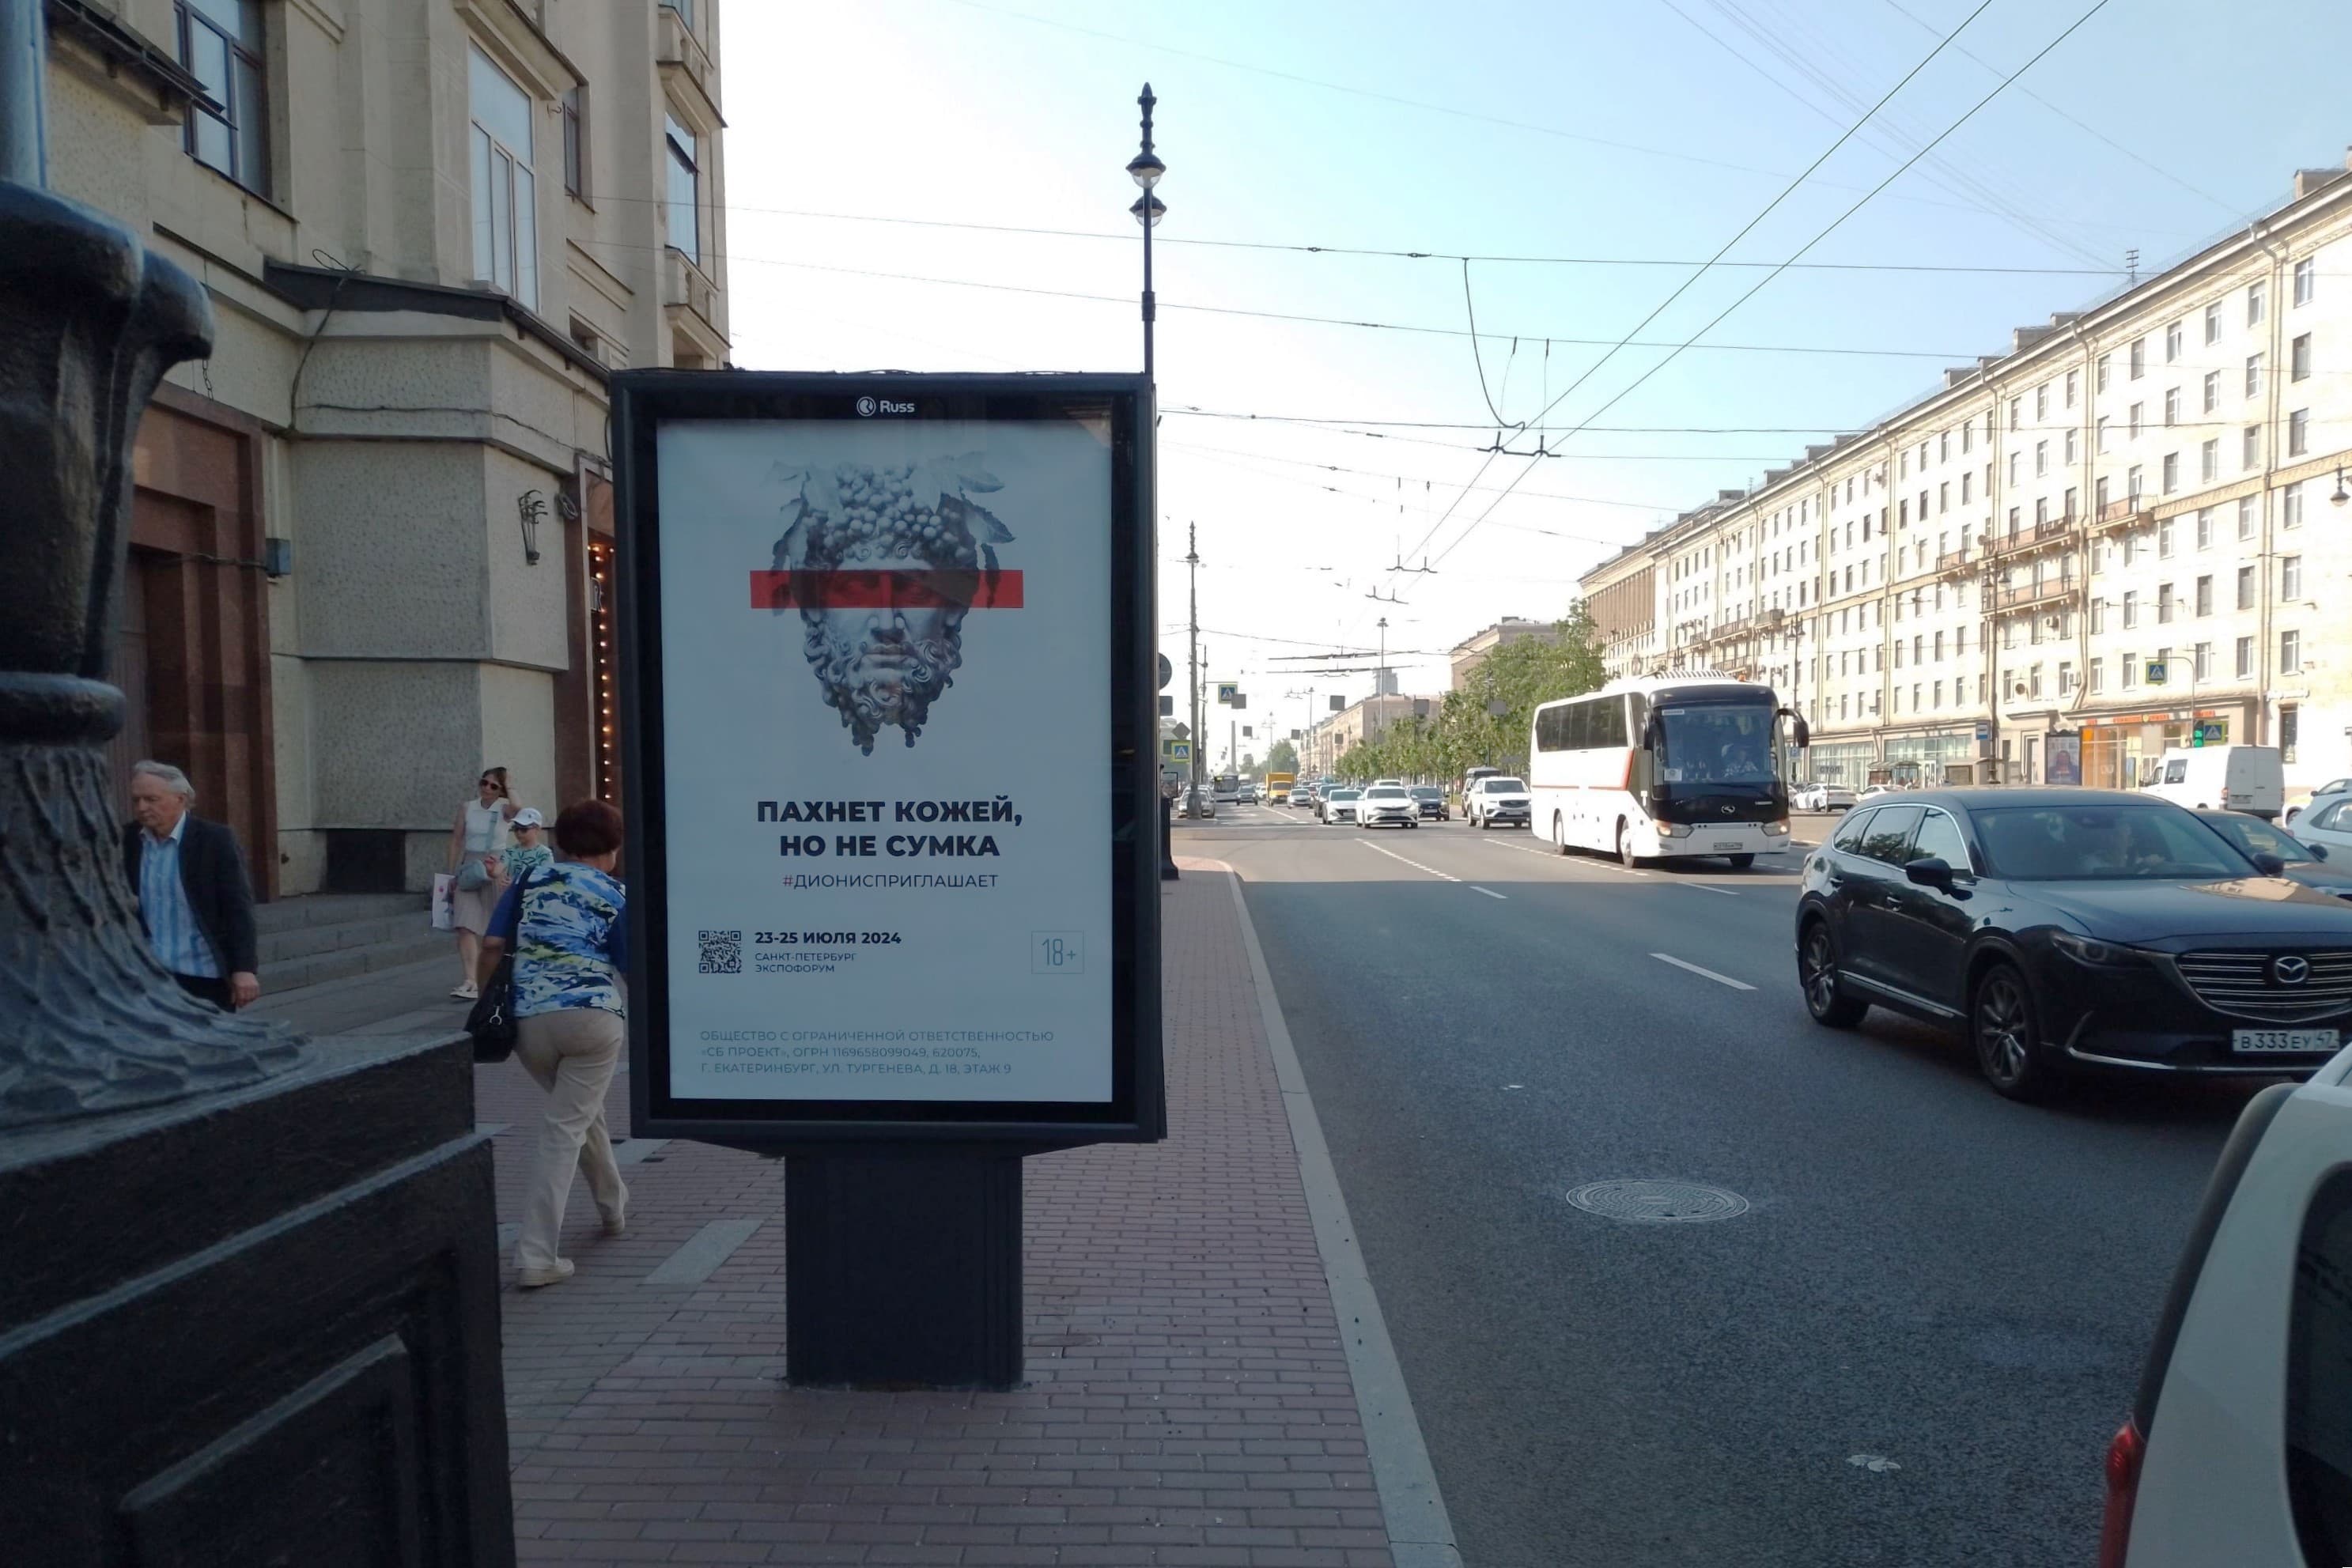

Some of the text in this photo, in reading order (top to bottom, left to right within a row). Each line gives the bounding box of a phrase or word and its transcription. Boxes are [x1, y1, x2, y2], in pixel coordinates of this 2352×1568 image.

[879, 400, 915, 413] Russ
[757, 794, 1023, 827] ПАХНЕТ КОЖЕЙ,
[780, 834, 1000, 857] НО НЕ СУМКА
[781, 873, 1000, 890] #ДИОНИСПРИГЛАШАЕТ
[754, 931, 902, 944] 23-25 ИЮЛЯ 2024
[754, 952, 856, 962] САНКТ-ПЕТЕРБУРГ
[1041, 938, 1077, 967] 18+
[754, 963, 835, 974] ЭКСПОФОРУМ
[700, 1029, 1054, 1043] ОБЩЕСТВО С ОГРАНИЧЕННОЙ ОТВЕТСТВЕННОСТЬЮ
[792, 1047, 829, 1058] ОГРН
[714, 1063, 819, 1075] ЕКАТЕРИНБУРГ,
[822, 1064, 842, 1074] УЛ.
[846, 1063, 925, 1075] ТУРГЕНЕВА,
[928, 1064, 943, 1075] Д.
[963, 1064, 1000, 1075] ЭТАЖ
[1004, 1064, 1012, 1075] 9
